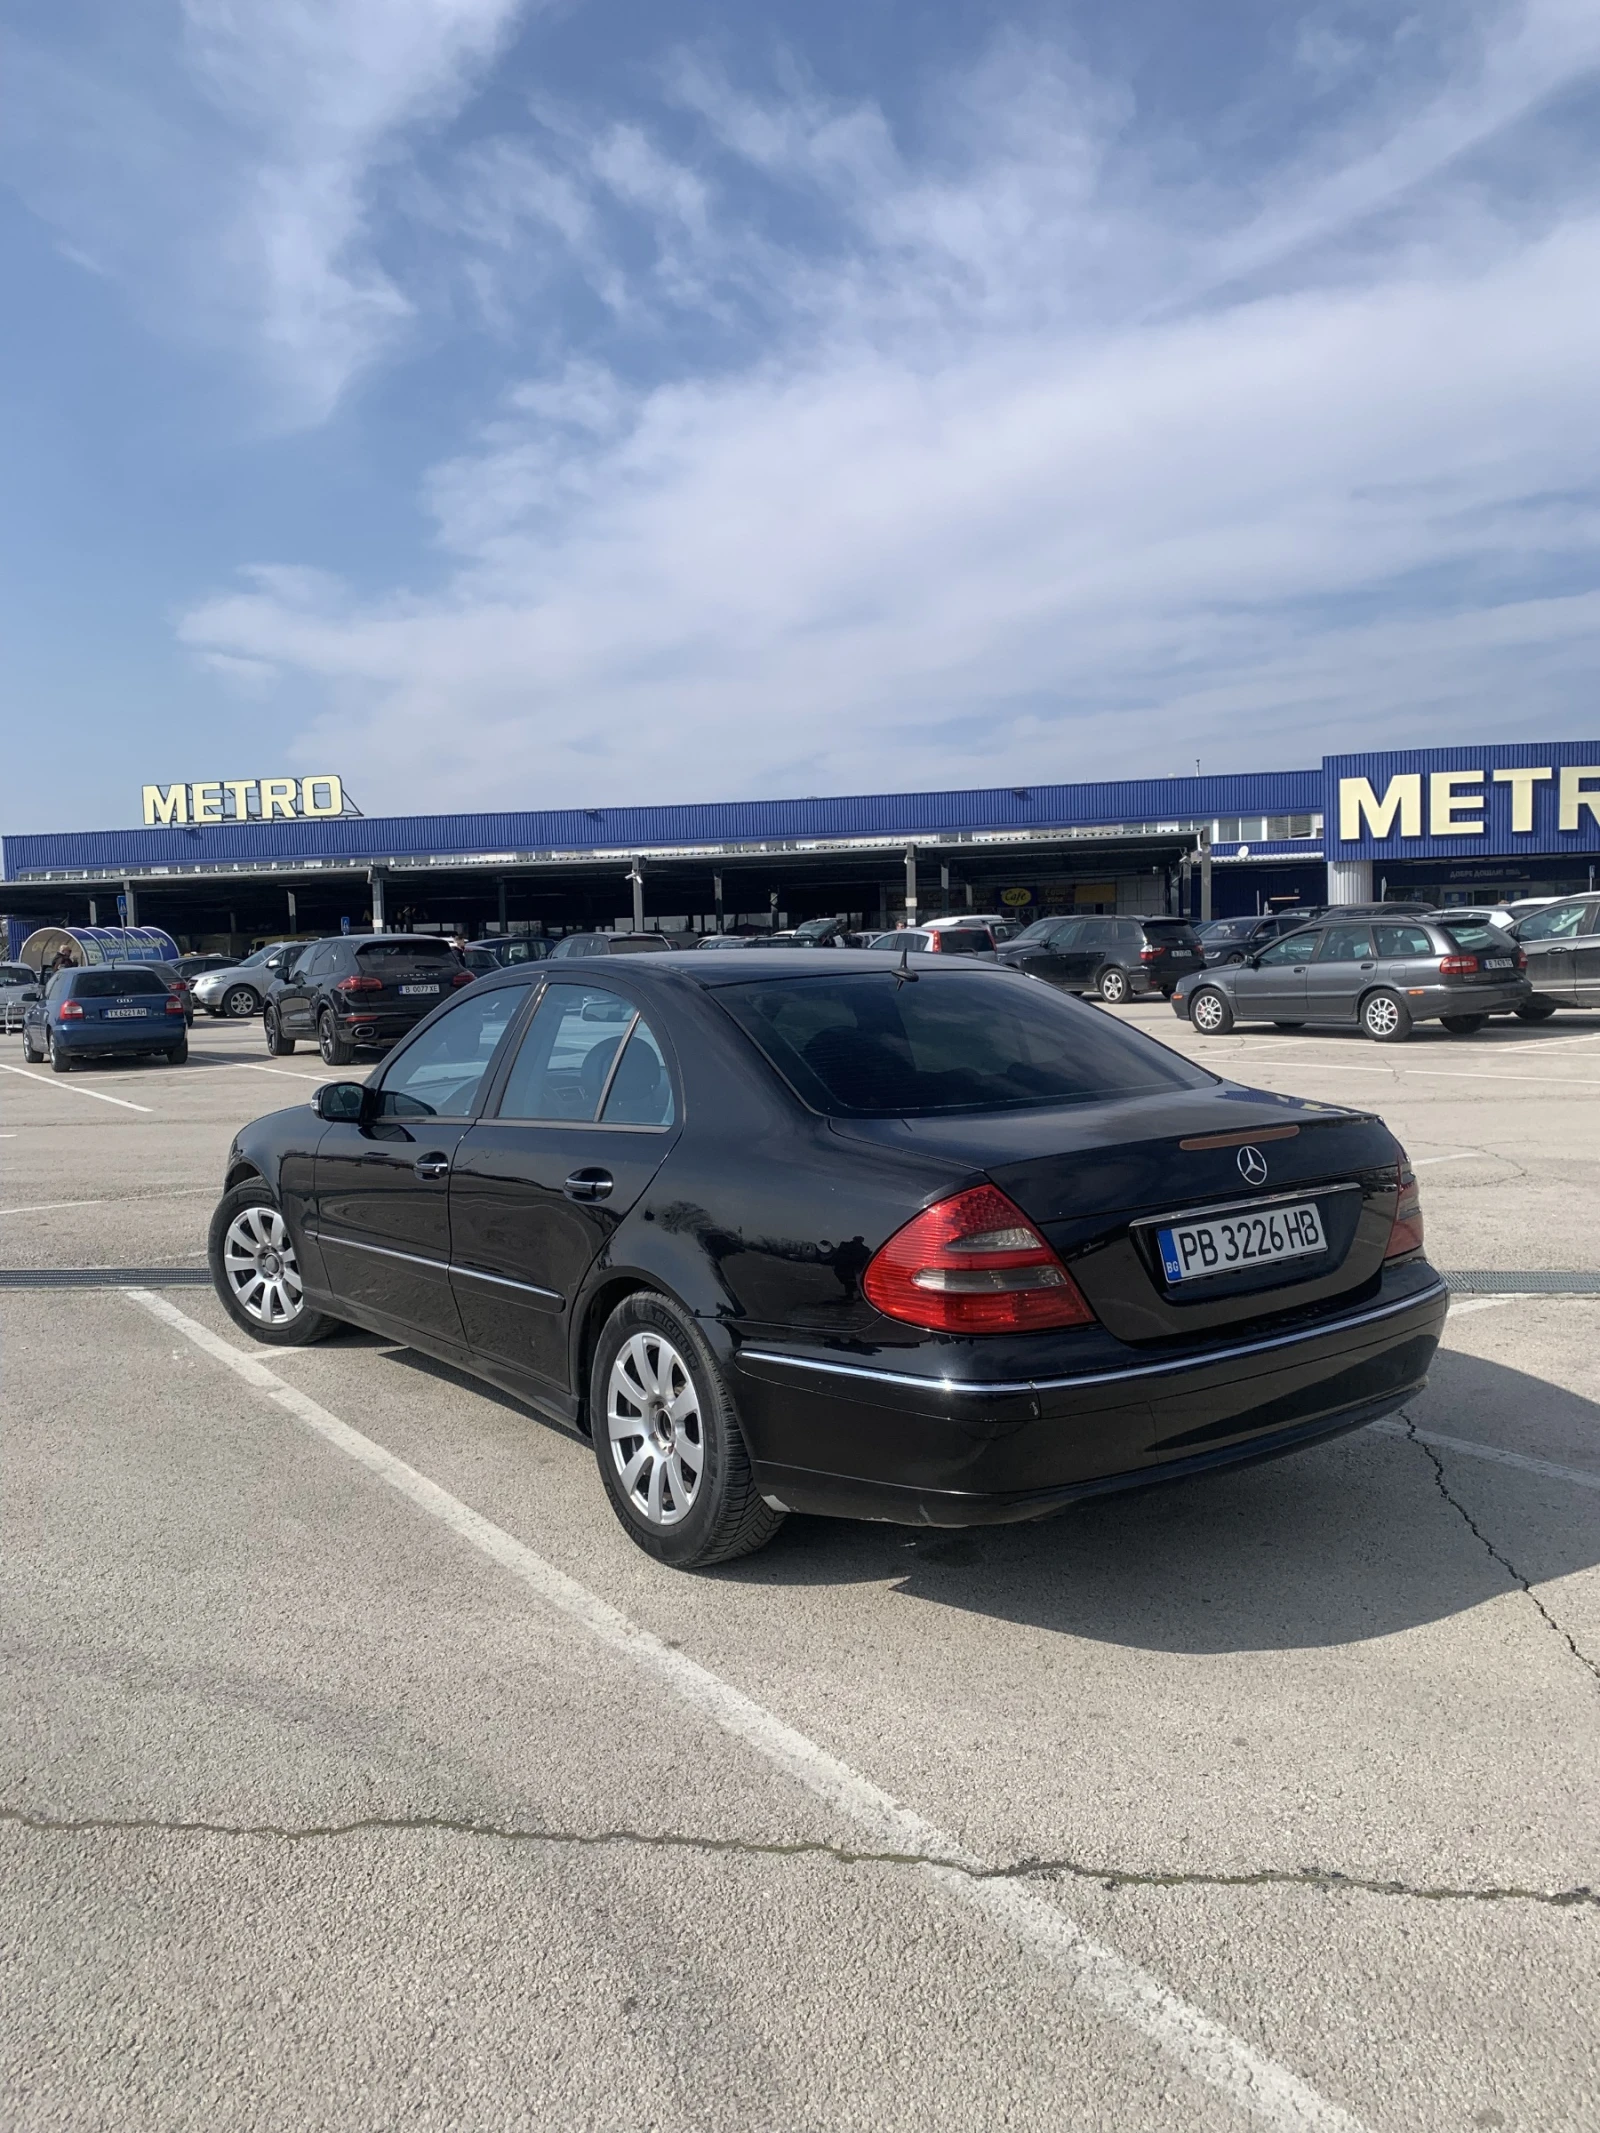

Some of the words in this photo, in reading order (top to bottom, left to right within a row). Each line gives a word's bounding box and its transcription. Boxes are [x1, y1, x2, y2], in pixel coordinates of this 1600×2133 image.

[142, 775, 344, 825] METRO
[1005, 890, 1027, 903] Cafe
[1178, 1229, 1219, 1271] PB
[1221, 1216, 1284, 1262] 3226
[1284, 1210, 1319, 1249] HB
[1166, 1260, 1179, 1273] BG
[652, 1309, 700, 1371] MICHELIN
